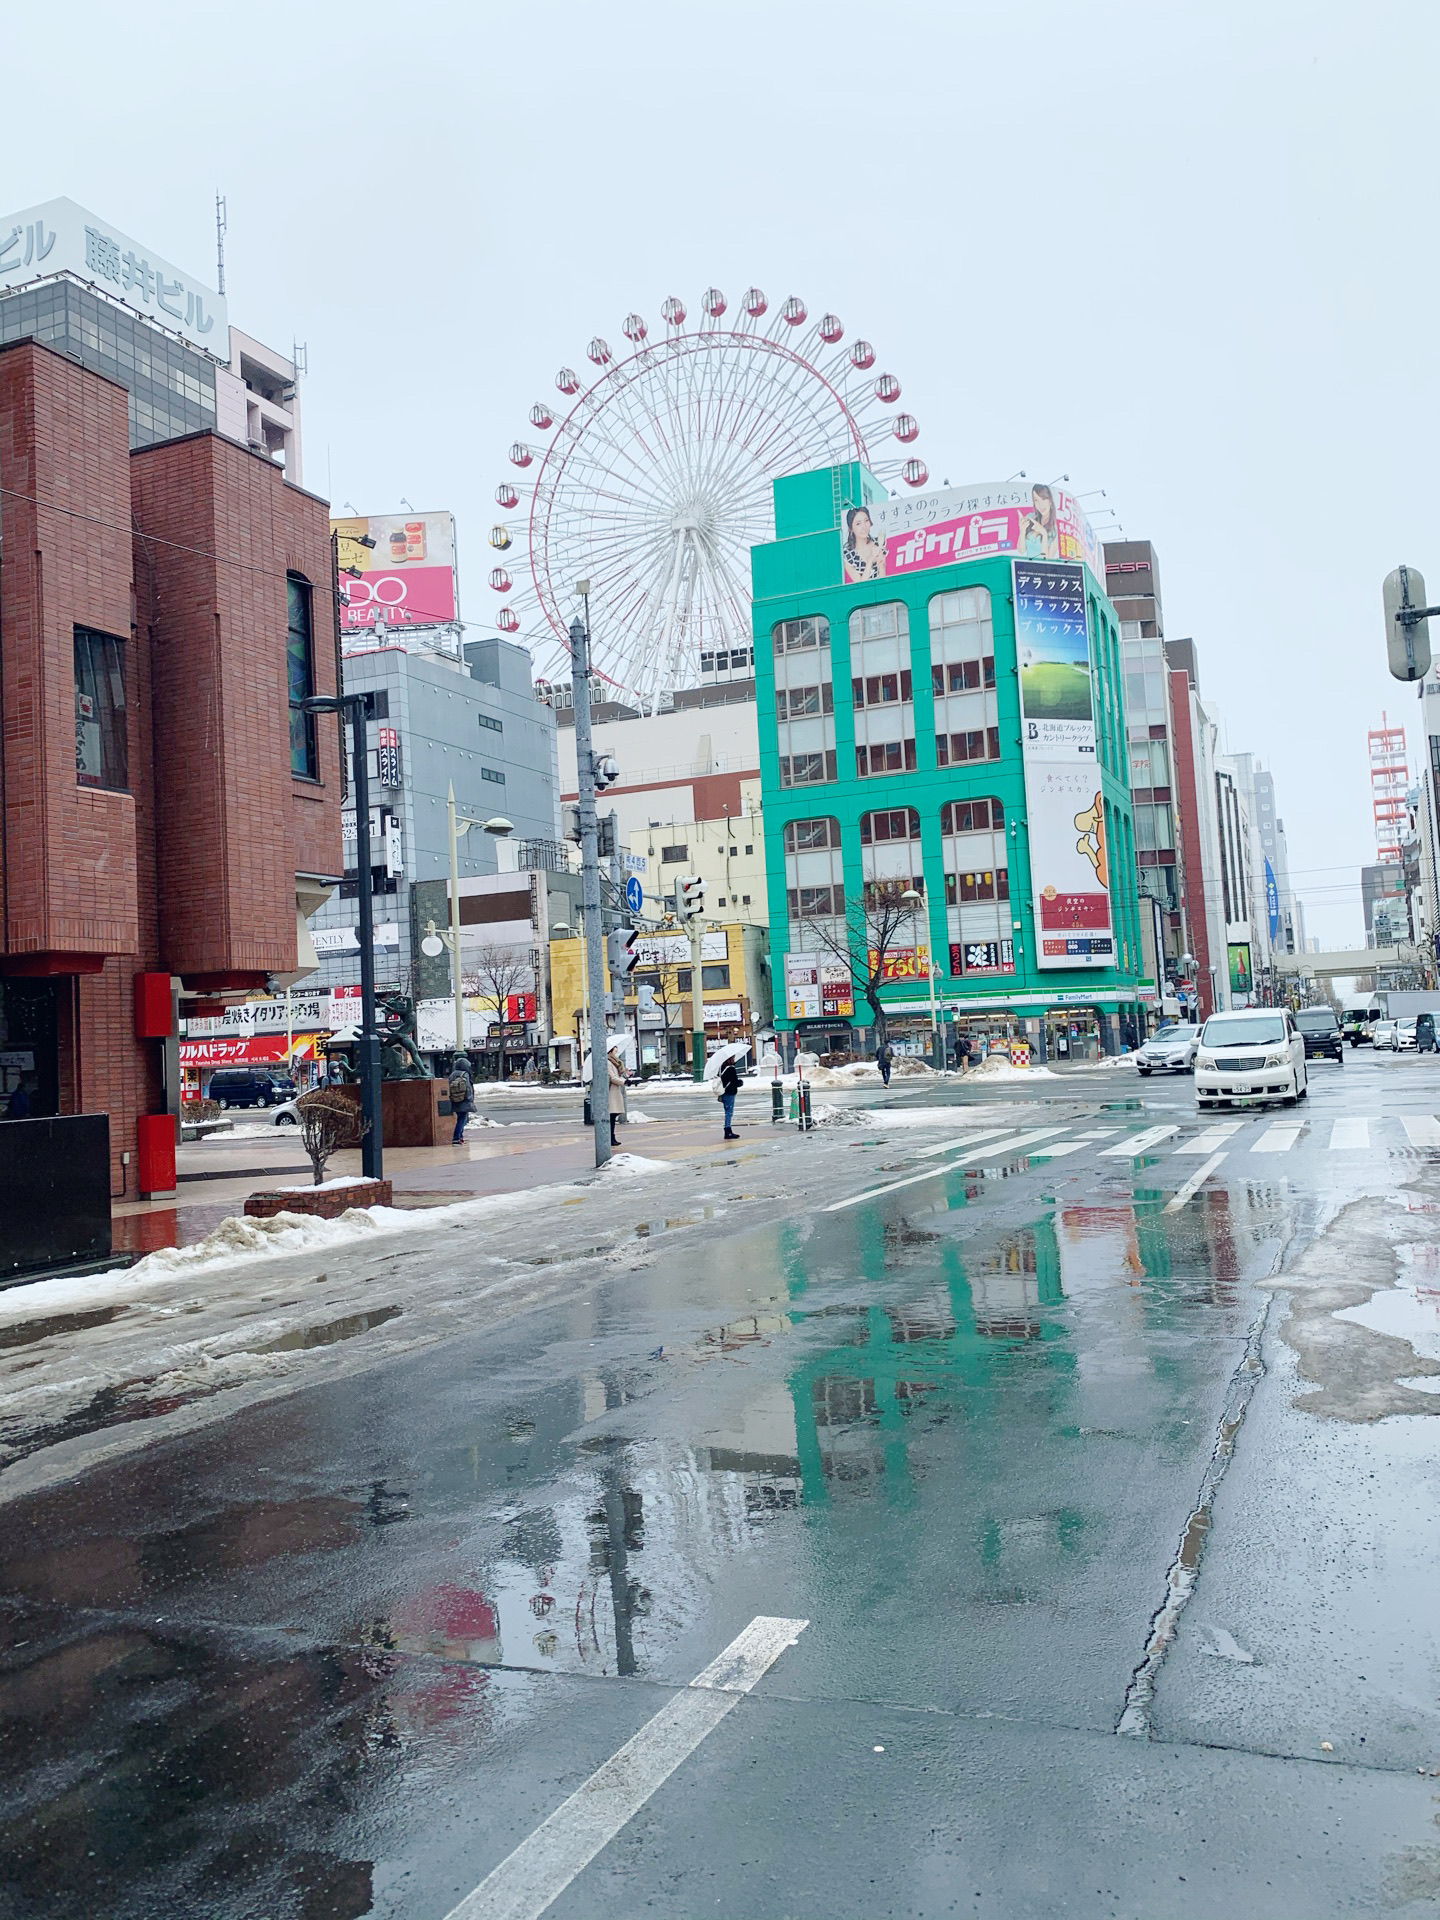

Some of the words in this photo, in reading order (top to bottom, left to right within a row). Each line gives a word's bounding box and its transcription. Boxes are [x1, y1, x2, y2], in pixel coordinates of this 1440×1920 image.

[84, 225, 214, 334] 藤井ビル
[877, 498, 939, 523] すすきのの
[896, 516, 1009, 566] ポケパラ
[1017, 576, 1083, 593] デラックス
[1019, 598, 1084, 614] リラックス
[1020, 620, 1085, 636] ブルックス
